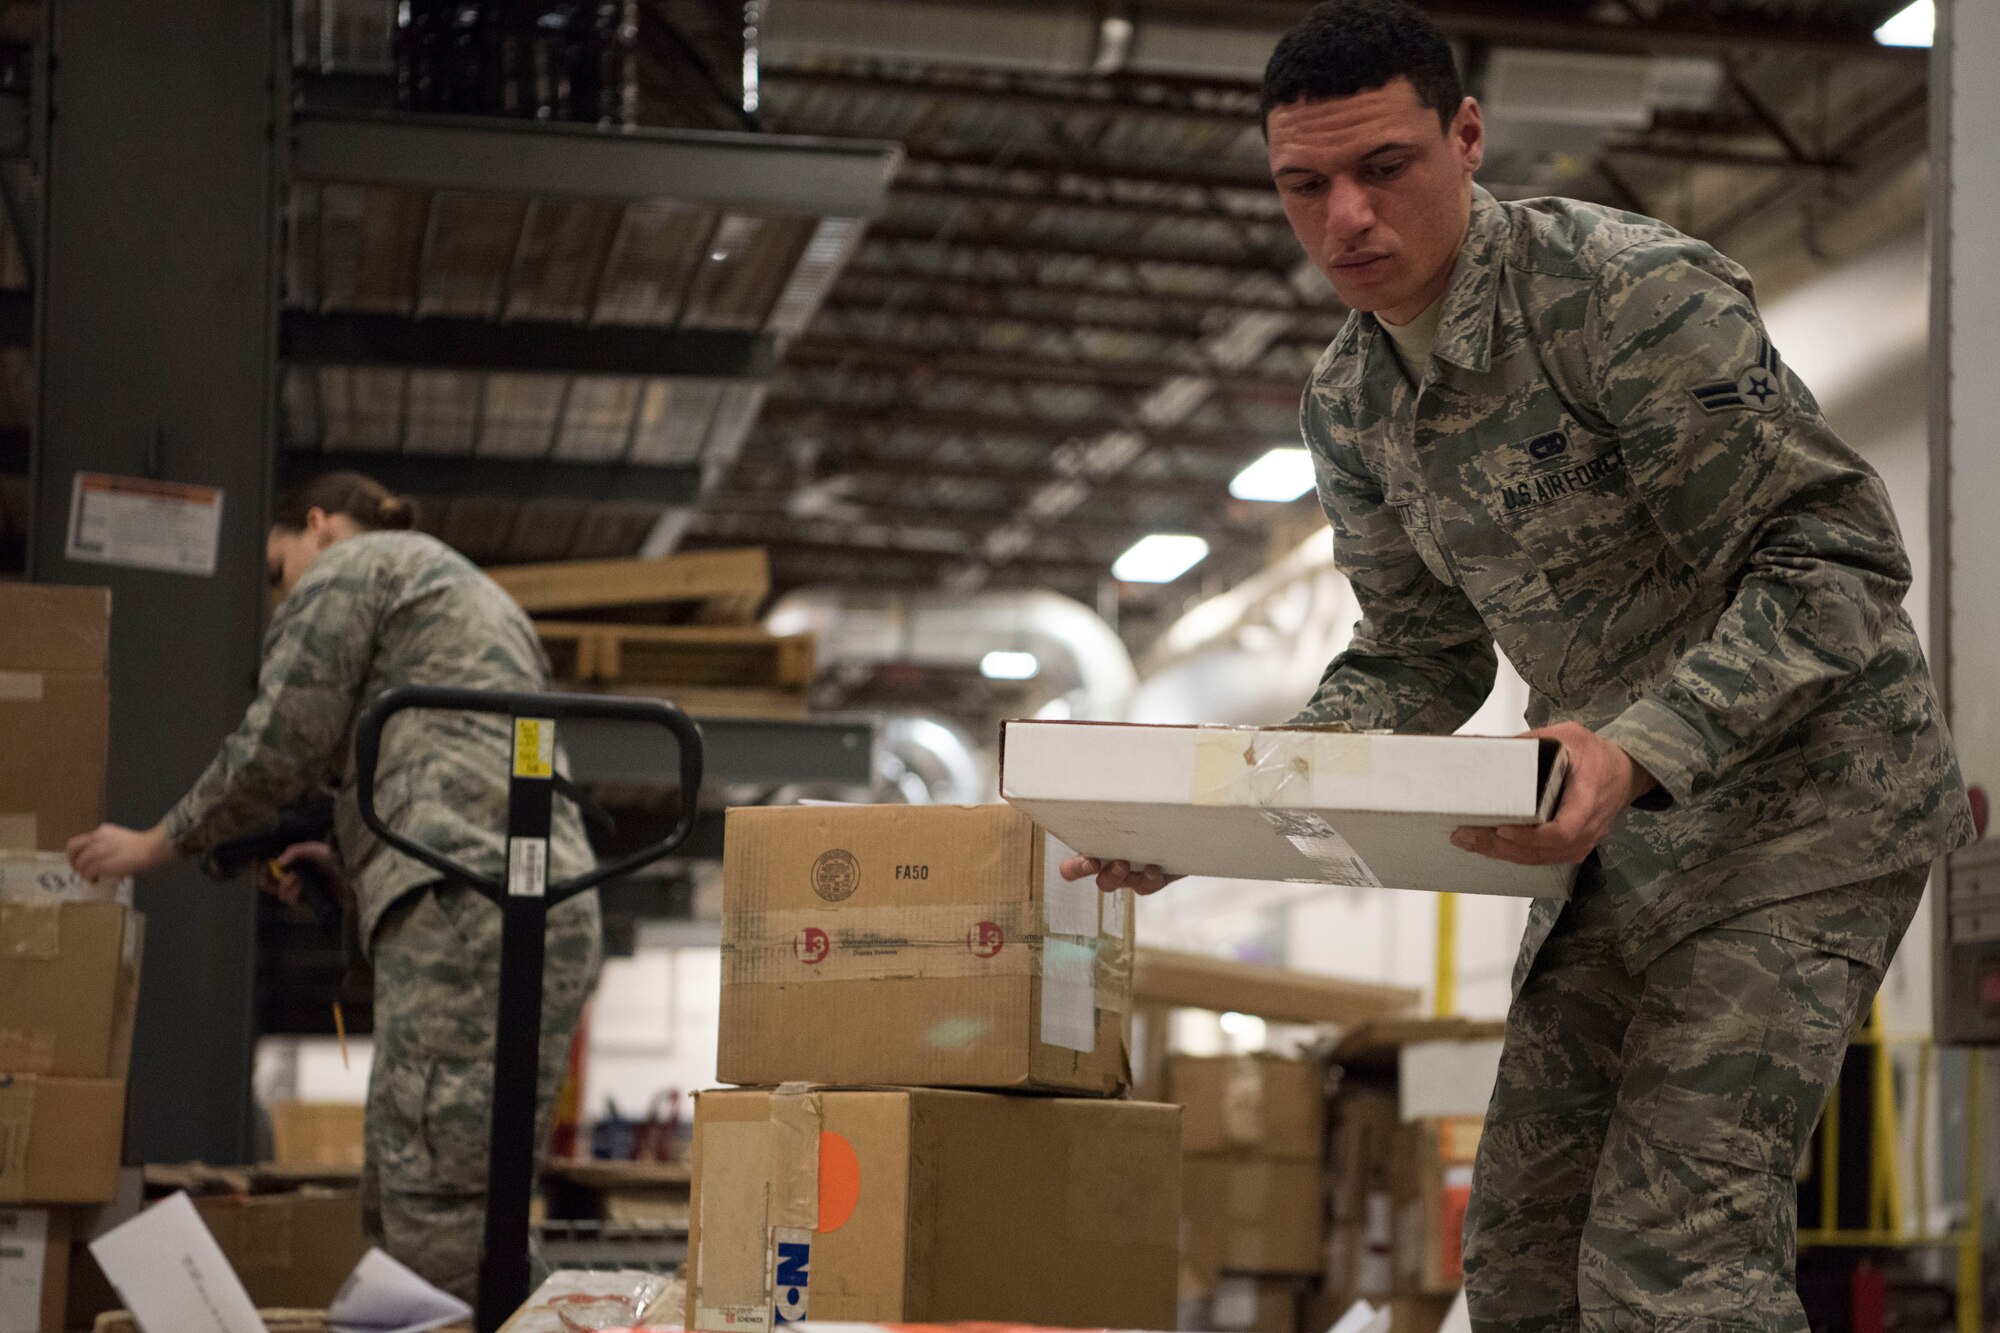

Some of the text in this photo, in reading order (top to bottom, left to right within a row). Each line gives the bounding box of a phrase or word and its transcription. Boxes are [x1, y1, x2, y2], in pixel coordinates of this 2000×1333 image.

[1502, 481, 1537, 509] U.S.
[1536, 473, 1568, 503] AIR
[895, 864, 929, 880] FA50
[795, 930, 826, 961] L3
[969, 923, 1002, 956] L3
